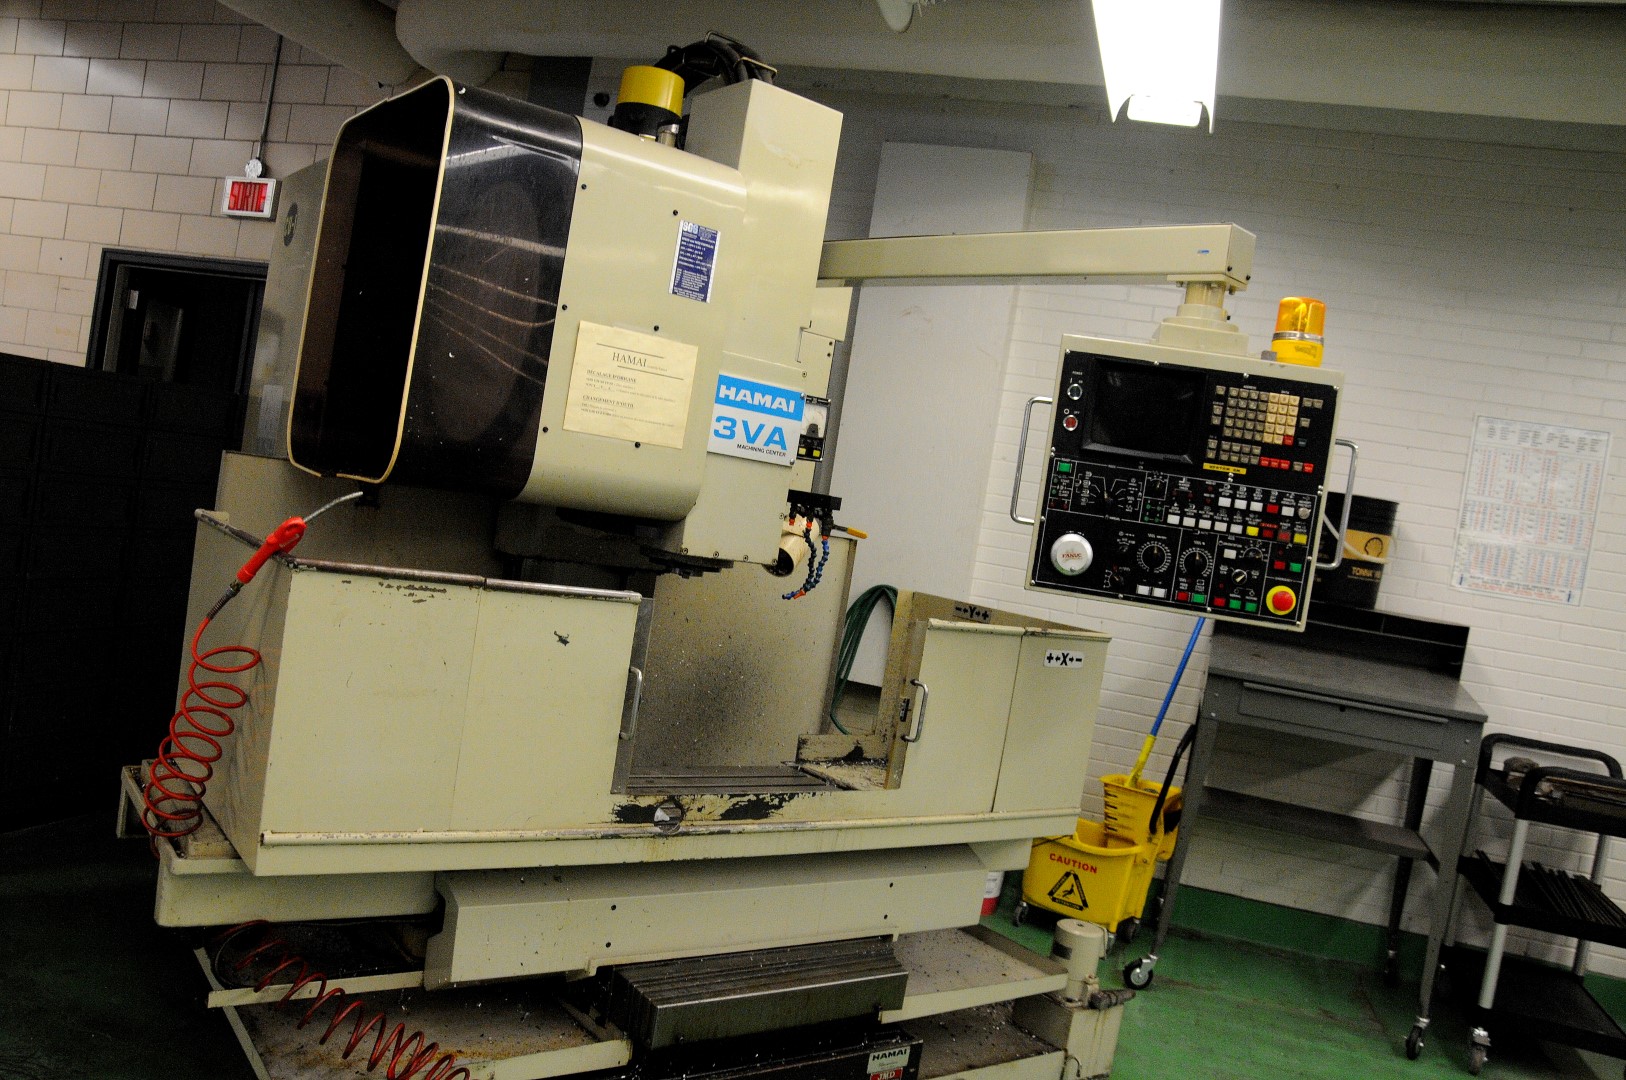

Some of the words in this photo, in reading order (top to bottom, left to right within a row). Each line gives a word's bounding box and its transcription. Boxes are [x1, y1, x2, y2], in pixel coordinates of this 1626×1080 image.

[612, 352, 647, 368] HAMAI
[719, 385, 796, 413] HAMAI
[713, 415, 788, 451] 3VA
[736, 443, 765, 454] MACHINING
[765, 449, 787, 459] CENTER
[1049, 852, 1098, 875] CAUTION
[872, 1048, 907, 1061] HAMAI
